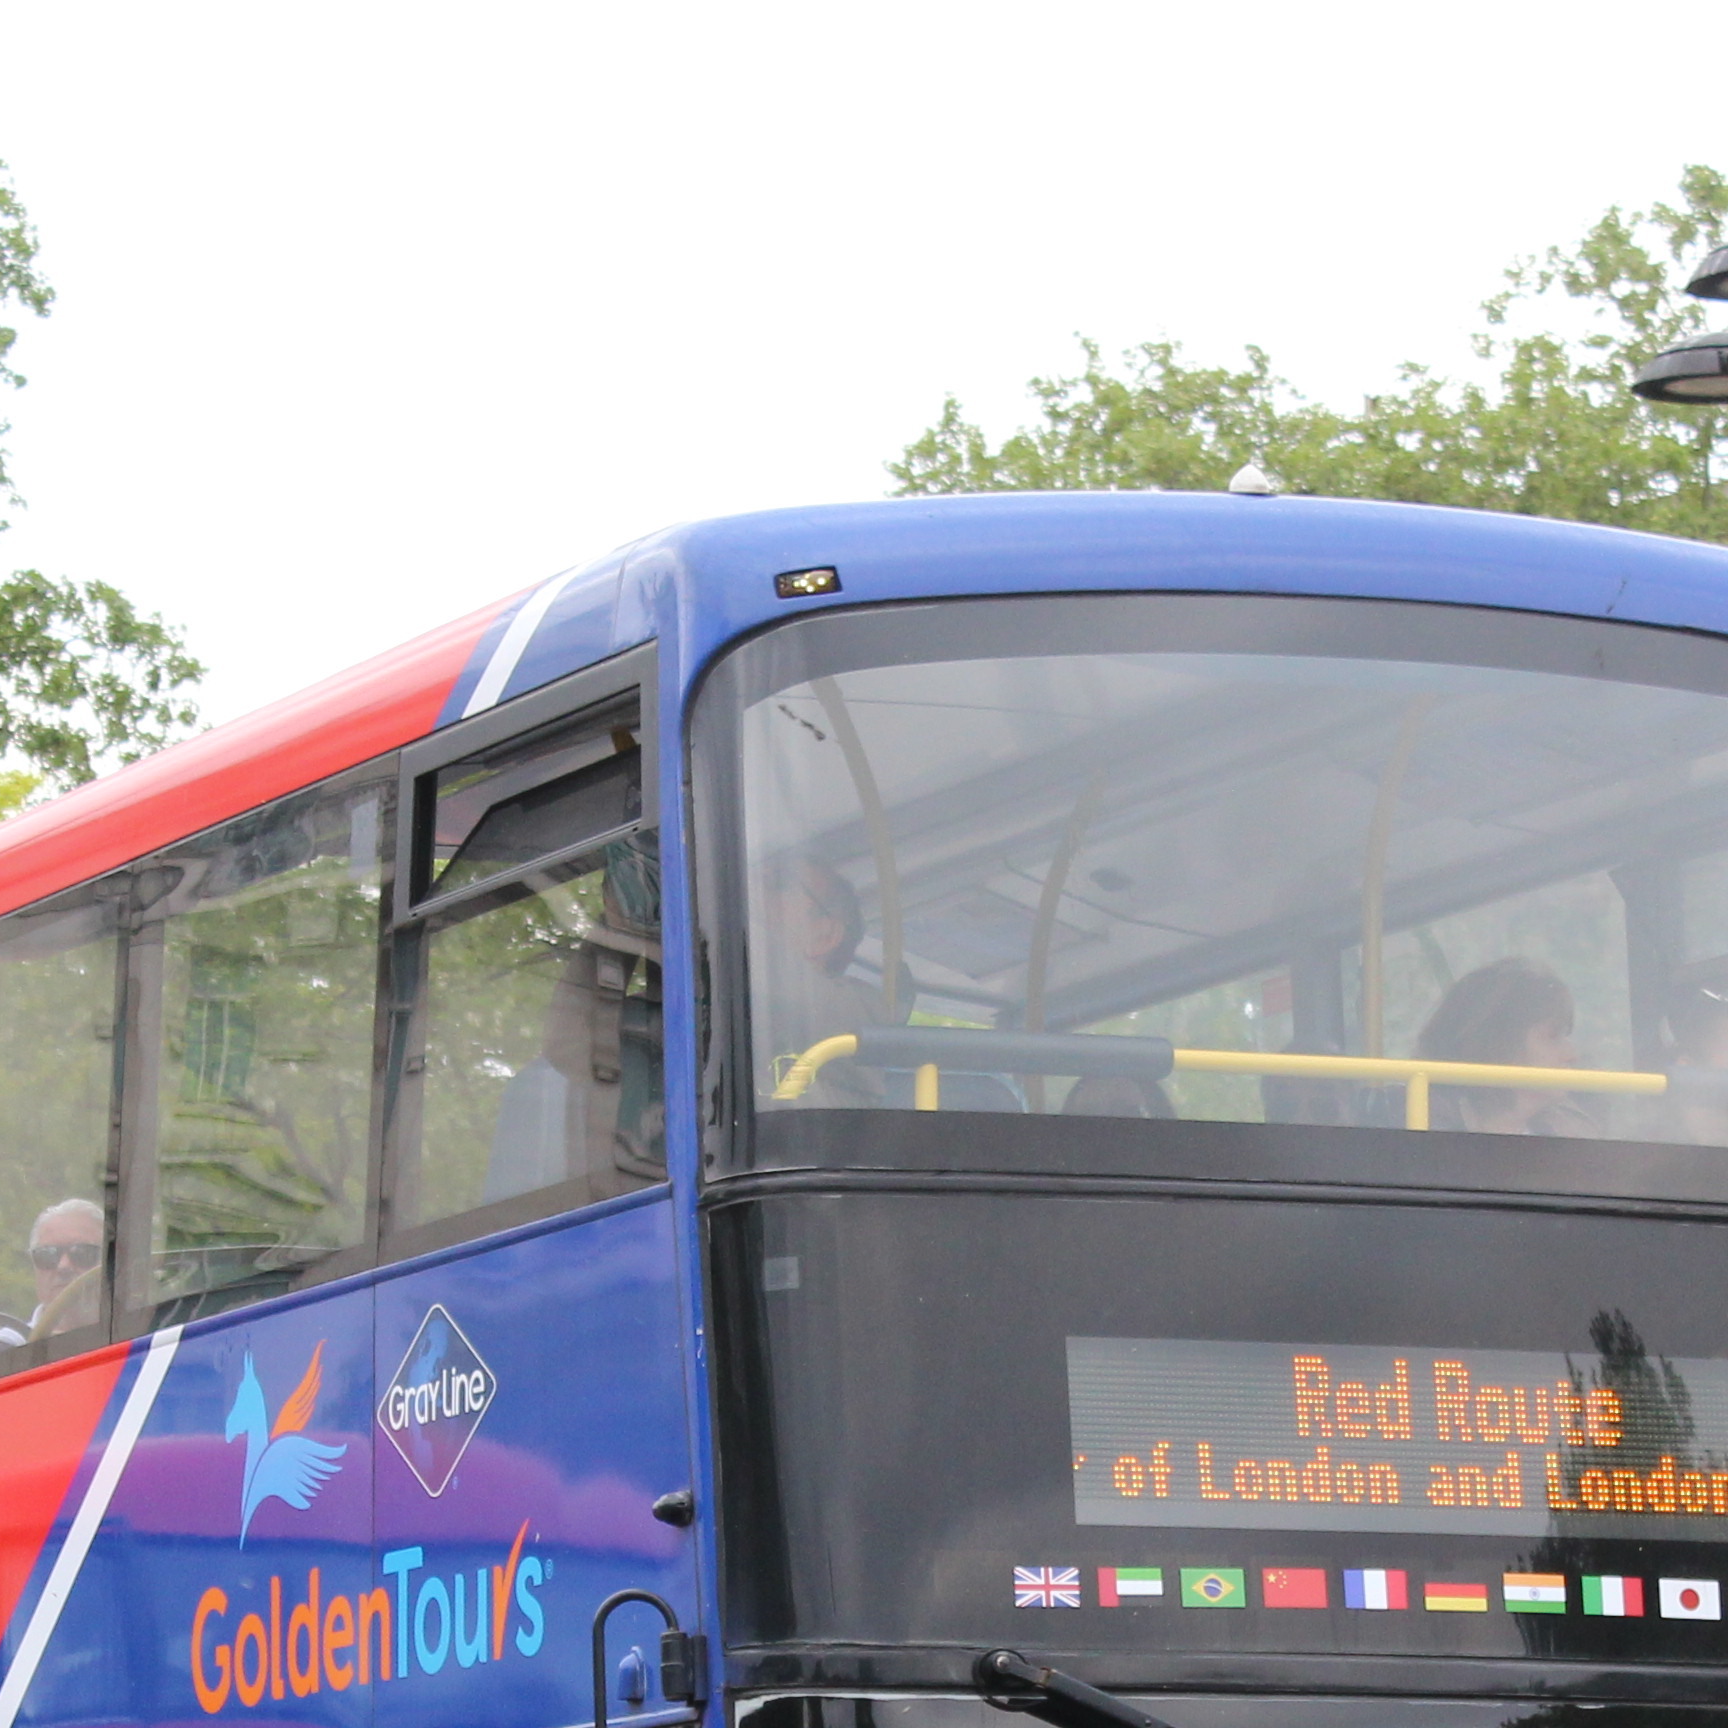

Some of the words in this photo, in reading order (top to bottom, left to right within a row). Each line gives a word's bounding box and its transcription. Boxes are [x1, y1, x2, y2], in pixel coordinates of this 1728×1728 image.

[1293, 1355, 1413, 1440] Red
[1433, 1359, 1624, 1447] Route
[1113, 1441, 1171, 1498] of
[1196, 1441, 1400, 1504] London
[1426, 1451, 1522, 1508] and
